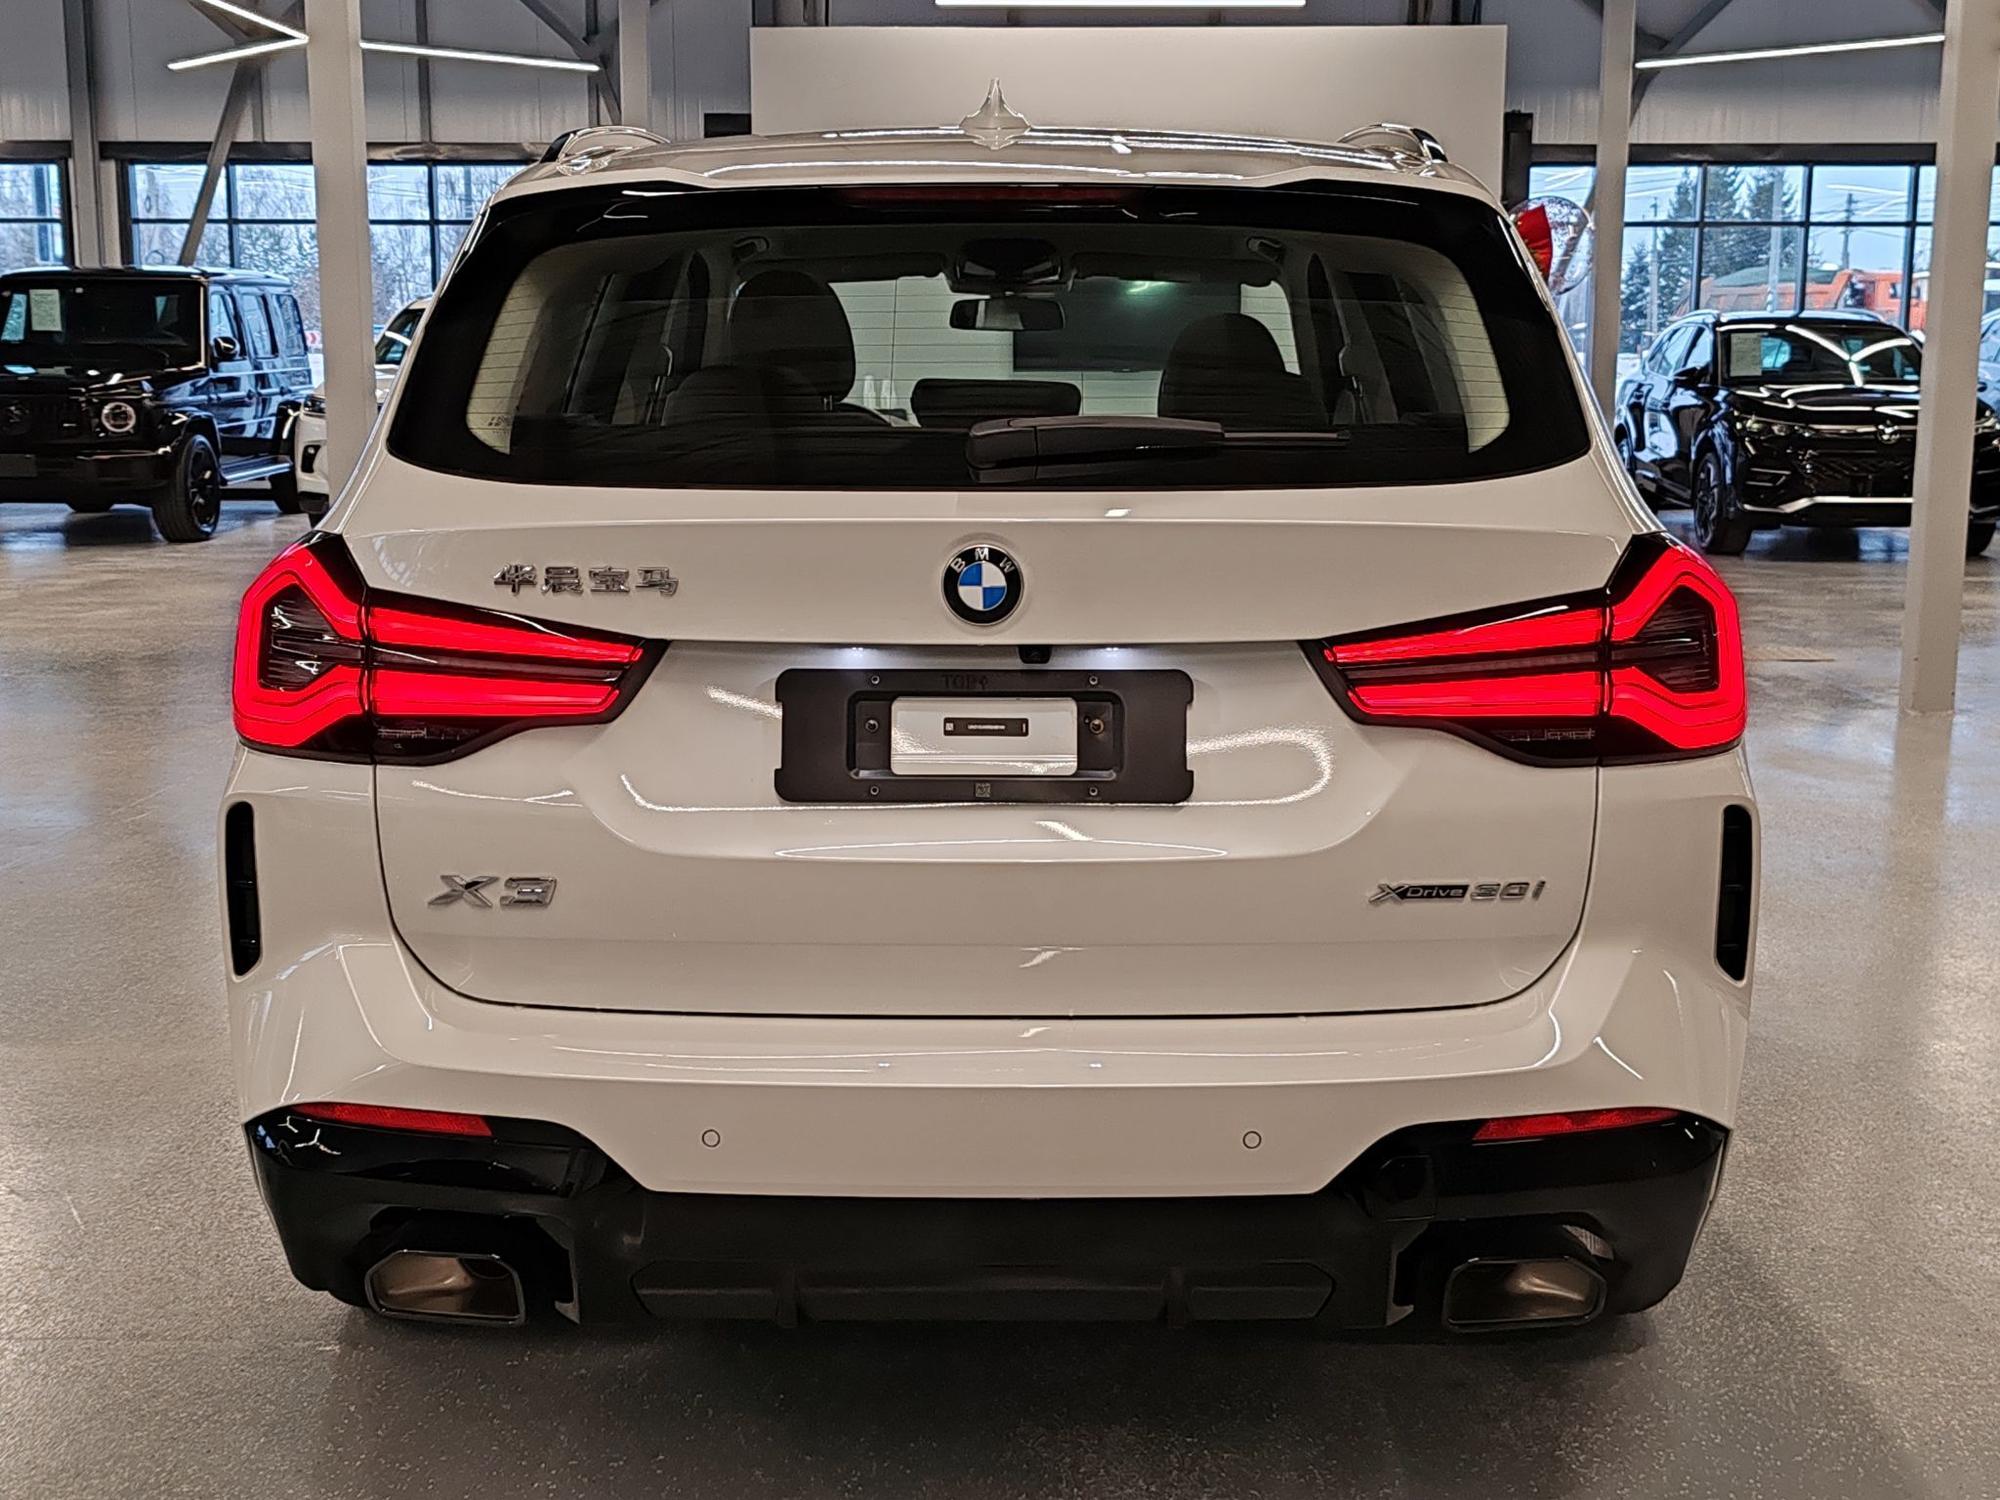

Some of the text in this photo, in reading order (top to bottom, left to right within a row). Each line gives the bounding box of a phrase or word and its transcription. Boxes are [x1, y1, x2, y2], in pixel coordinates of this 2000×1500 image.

[949, 547, 1015, 574] BMW
[494, 563, 679, 597] 华晨宝马
[427, 875, 557, 908] X3
